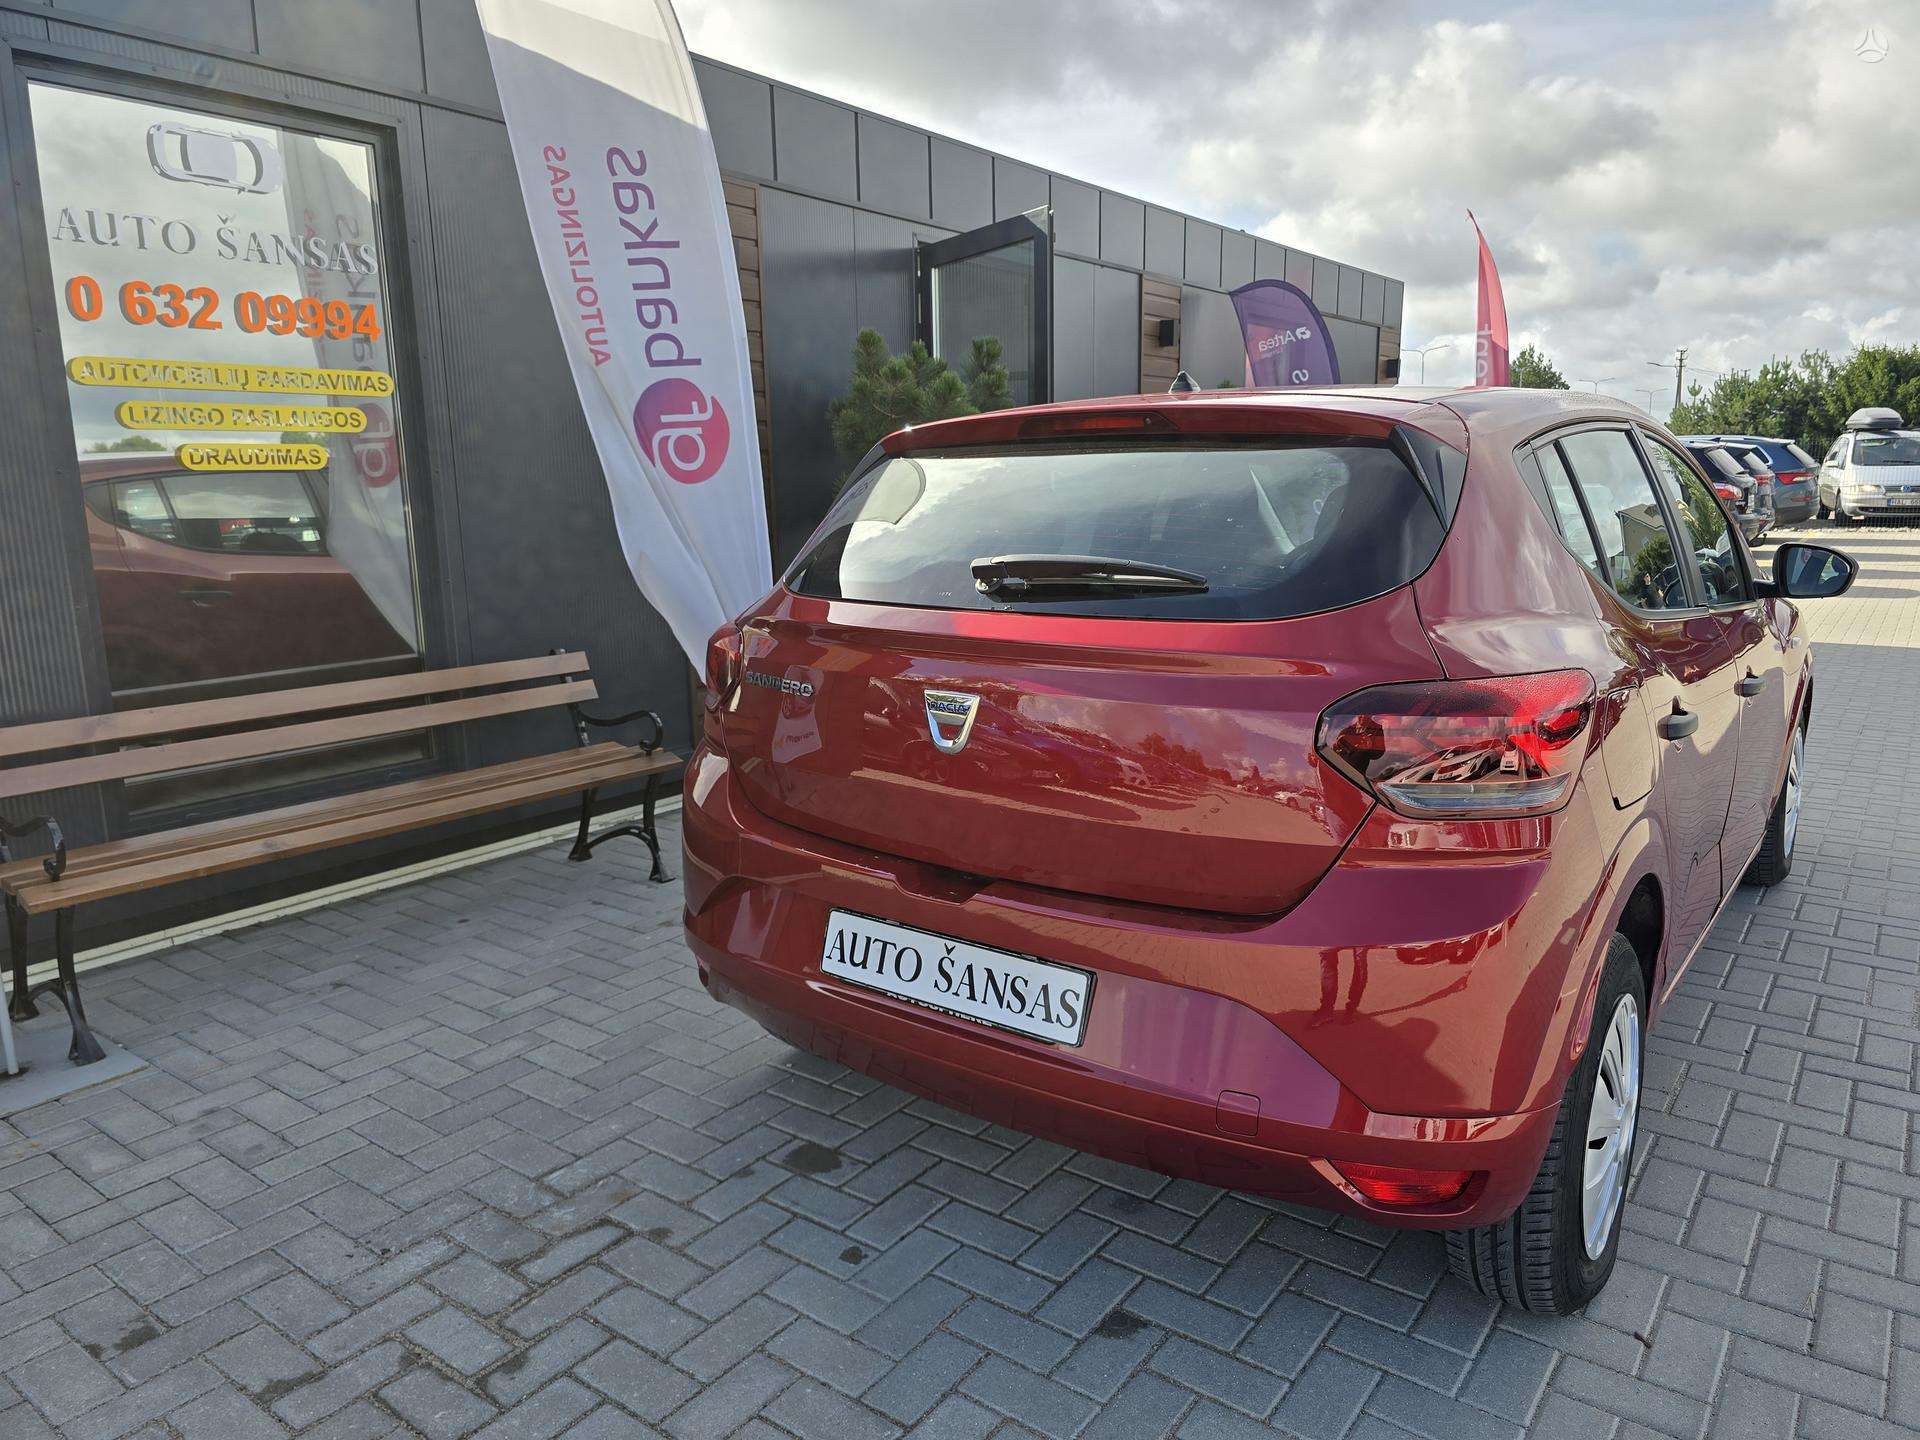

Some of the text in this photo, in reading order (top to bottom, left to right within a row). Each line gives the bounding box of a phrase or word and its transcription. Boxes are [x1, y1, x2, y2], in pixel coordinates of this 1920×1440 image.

[52, 207, 197, 255] AUTO
[216, 213, 378, 275] ŠANSAS
[65, 275, 381, 343] 0 632 09994
[79, 361, 390, 393] AUTOMOBILIŲ PARDAVIMAS
[128, 405, 362, 428] LIZINGO PASLAUGOS
[188, 447, 322, 467] DRAUDIMAS
[745, 671, 813, 697] SANDERO
[930, 700, 969, 713] DACIA
[825, 928, 922, 983] AUTO
[933, 942, 1080, 1028] ŠANSAS
